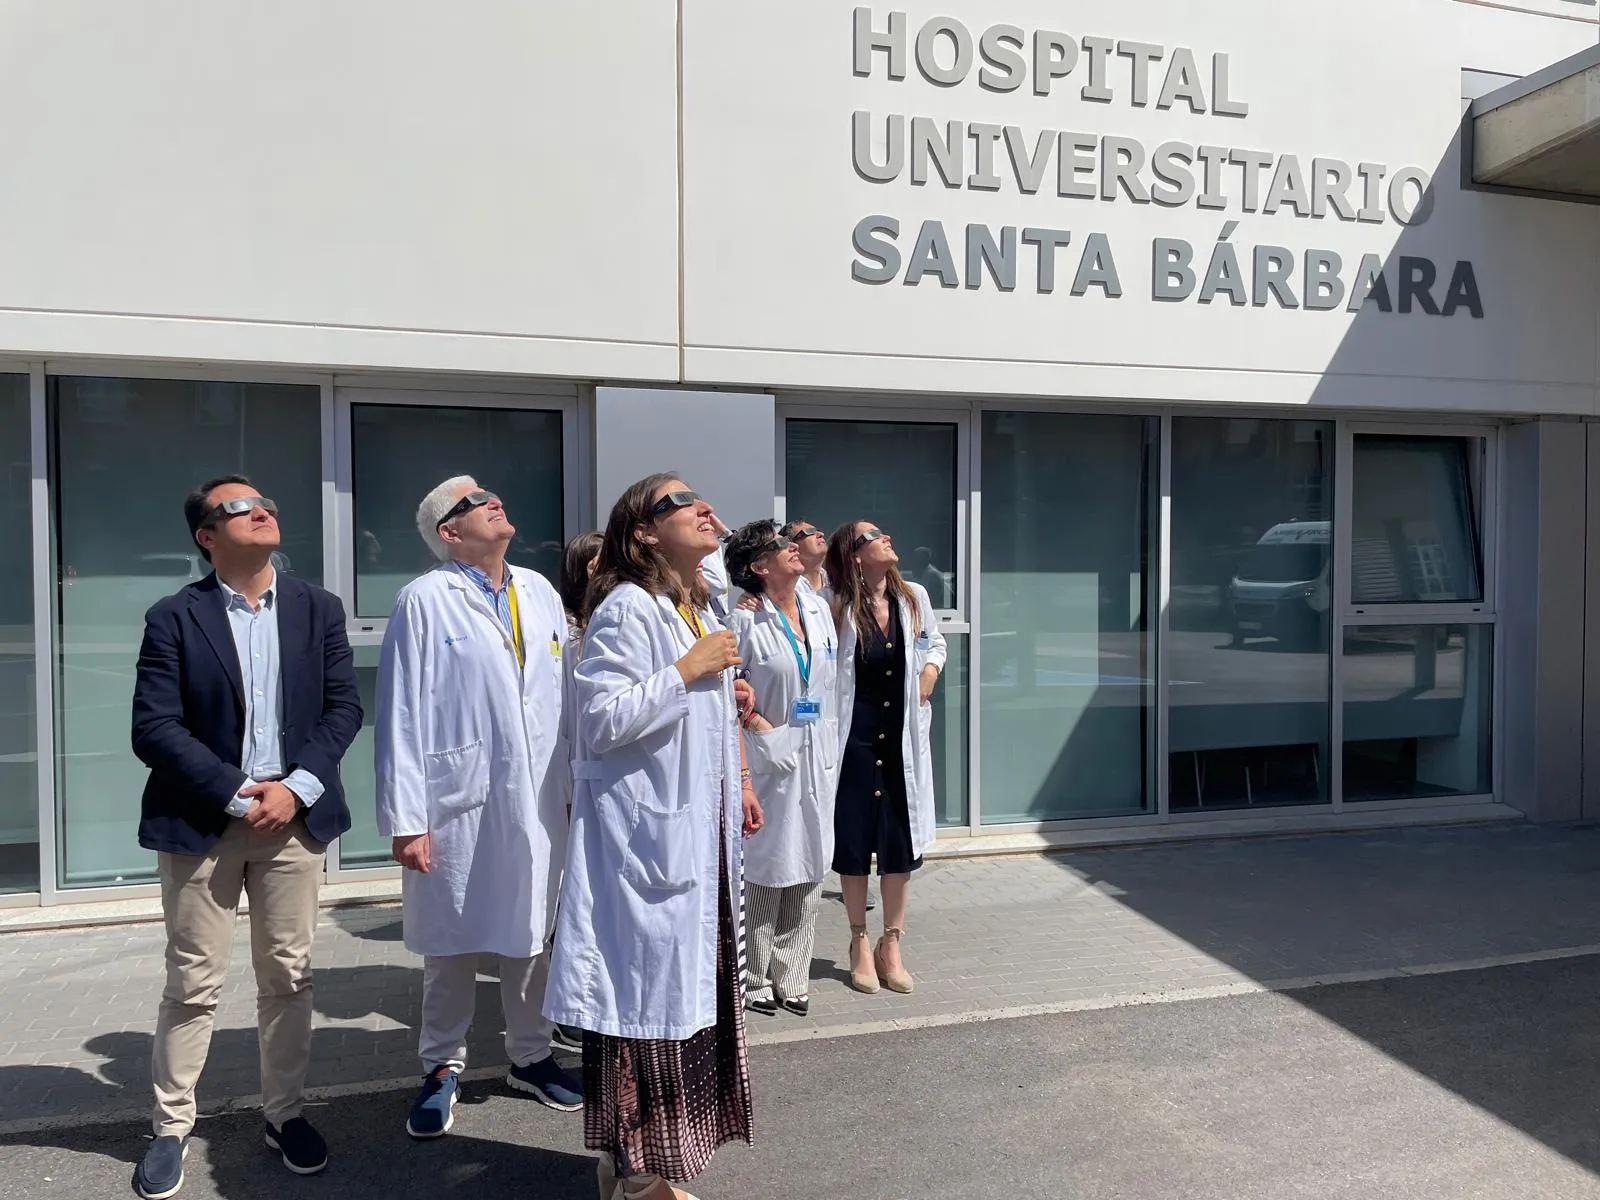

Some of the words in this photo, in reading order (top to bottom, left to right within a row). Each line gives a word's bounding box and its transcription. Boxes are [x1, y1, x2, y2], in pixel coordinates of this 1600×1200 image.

[852, 7, 1248, 119] HOSPITAL
[851, 111, 1435, 226] UNIVERSITARIO
[851, 215, 1122, 298] SANTA
[1152, 220, 1485, 319] BÁRBARA
